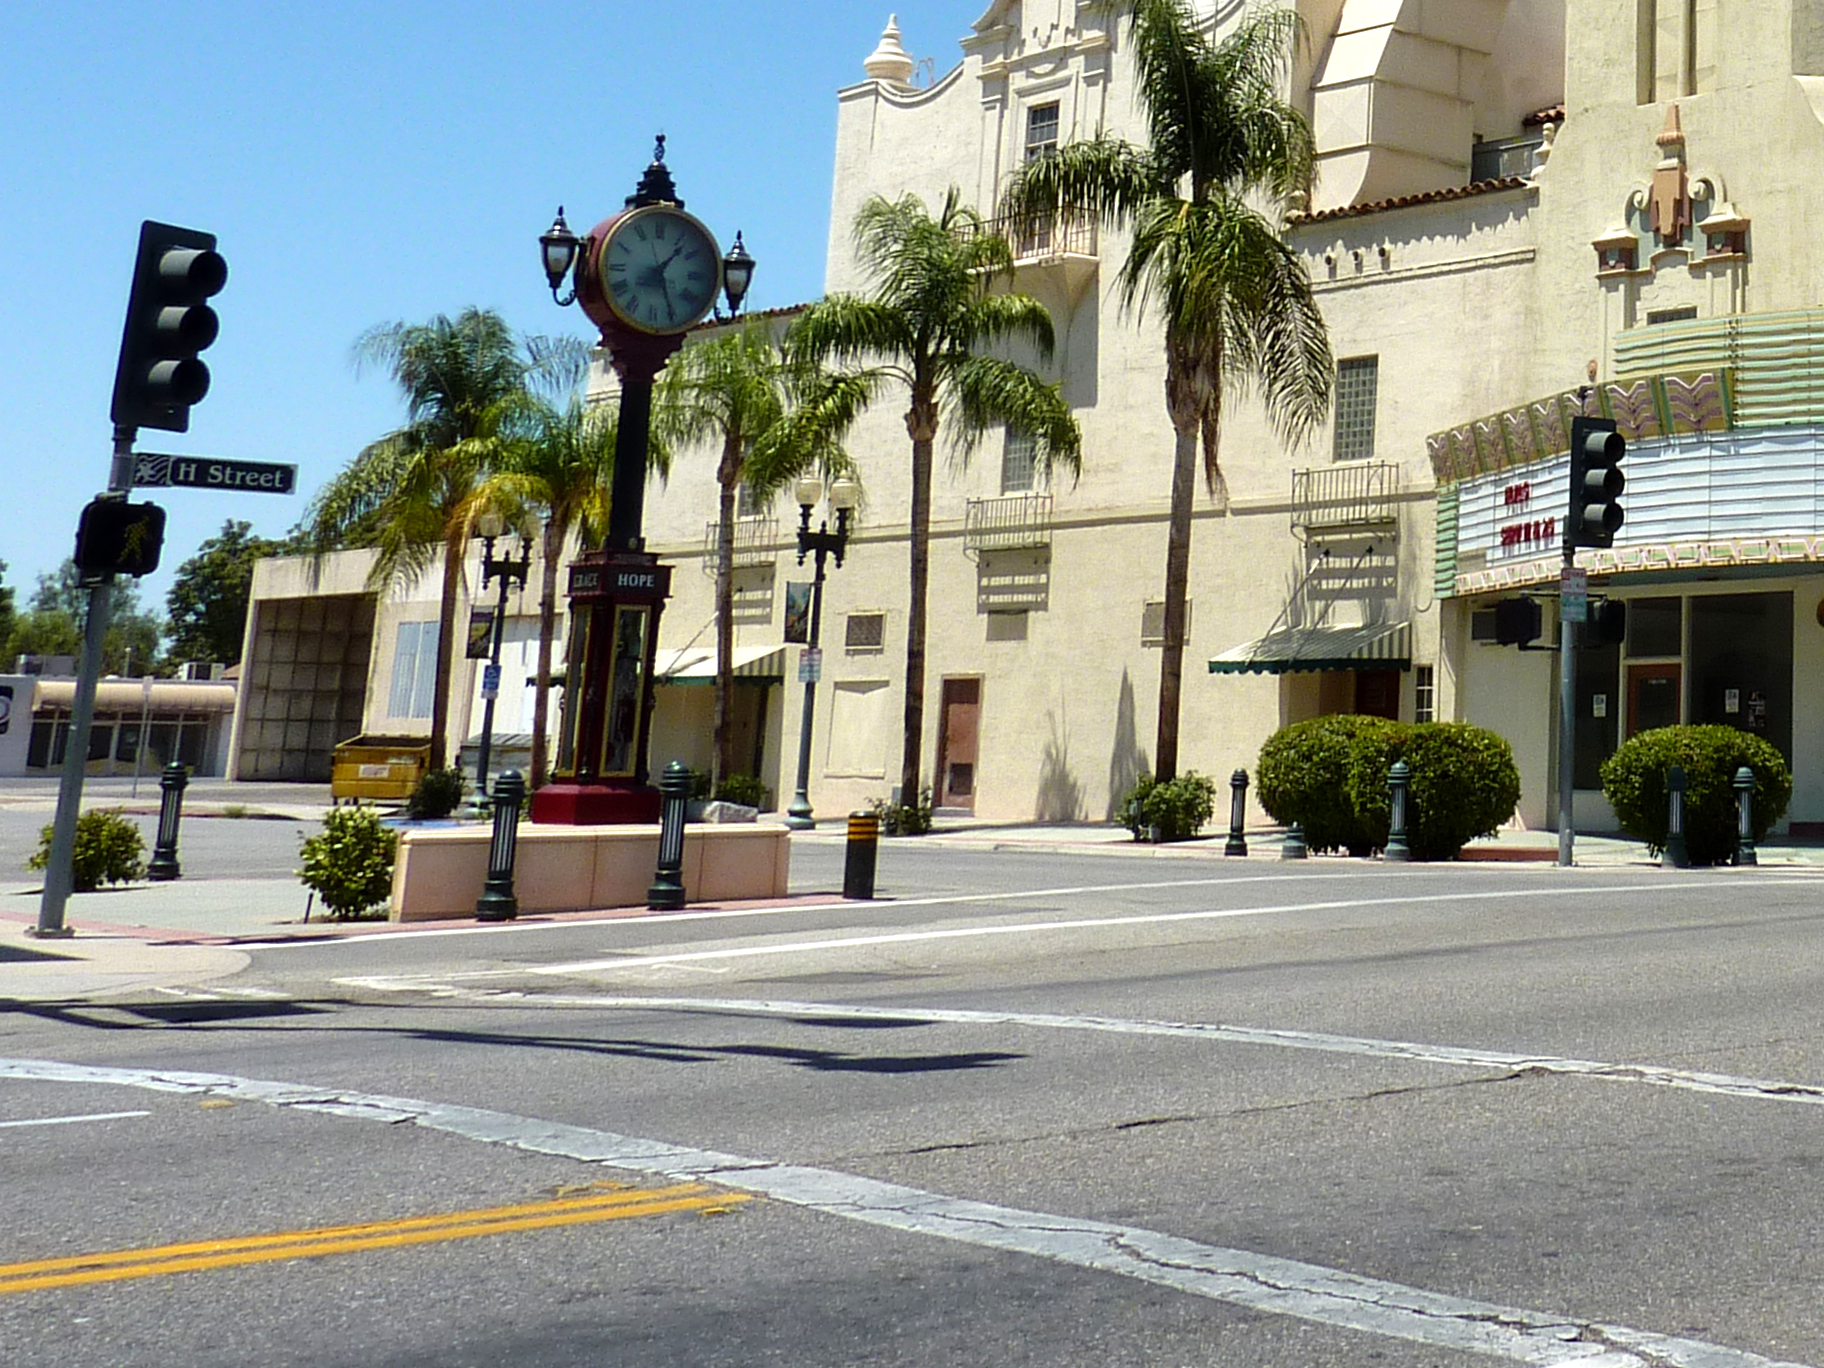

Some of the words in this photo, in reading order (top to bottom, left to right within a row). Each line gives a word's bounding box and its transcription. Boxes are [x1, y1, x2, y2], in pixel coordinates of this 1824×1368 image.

[177, 463, 198, 481] H
[208, 465, 285, 488] Street
[617, 573, 654, 587] HOPE
